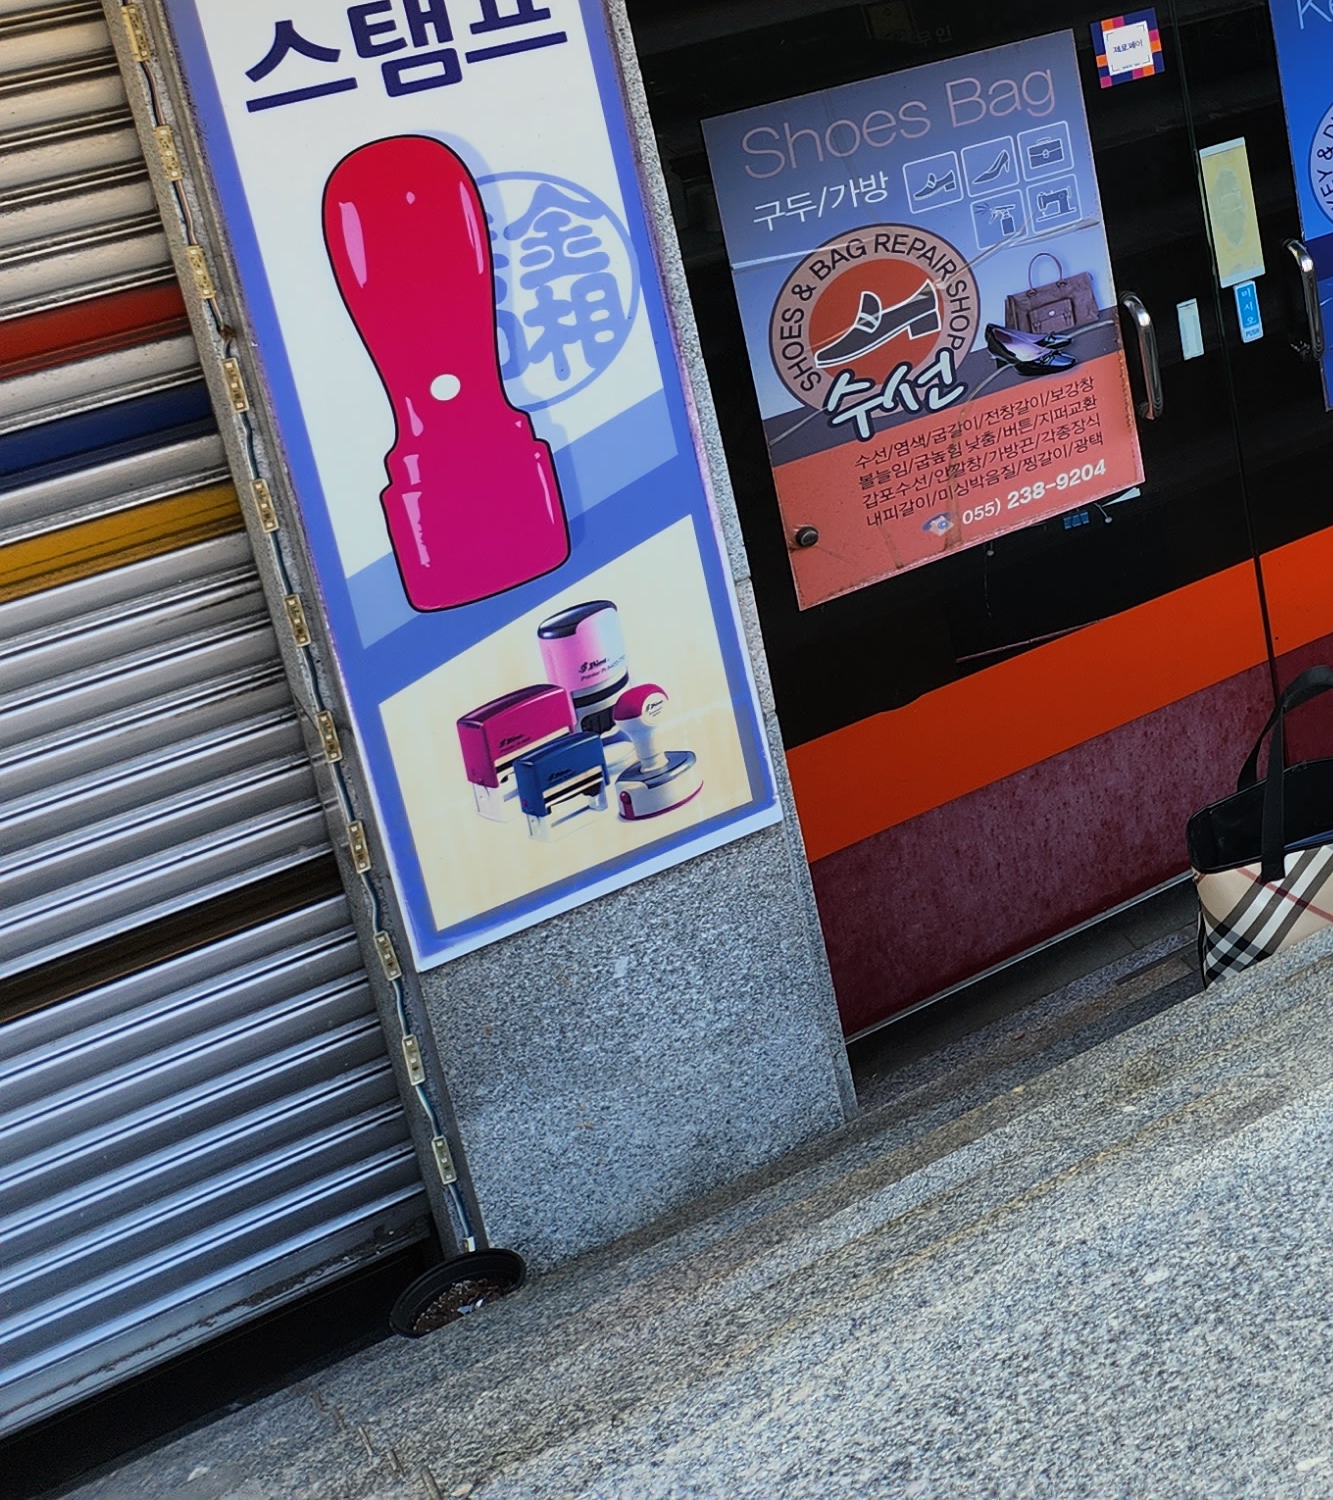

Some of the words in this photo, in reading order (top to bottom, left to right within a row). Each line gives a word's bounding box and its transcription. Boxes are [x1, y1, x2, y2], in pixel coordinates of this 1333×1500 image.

[1112, 38, 1144, 54] 제로페이
[742, 101, 931, 180] Shoes
[946, 68, 1056, 129] Bag
[753, 171, 888, 232] 구두/가방
[810, 237, 868, 283] BAG
[874, 232, 957, 282] REPAIR
[791, 281, 816, 303] &
[944, 279, 972, 352] SHOP
[780, 305, 823, 393] SHOES
[825, 351, 966, 439] 수선
[962, 498, 1002, 526] 055)
[1006, 459, 1108, 511] 238-9204
